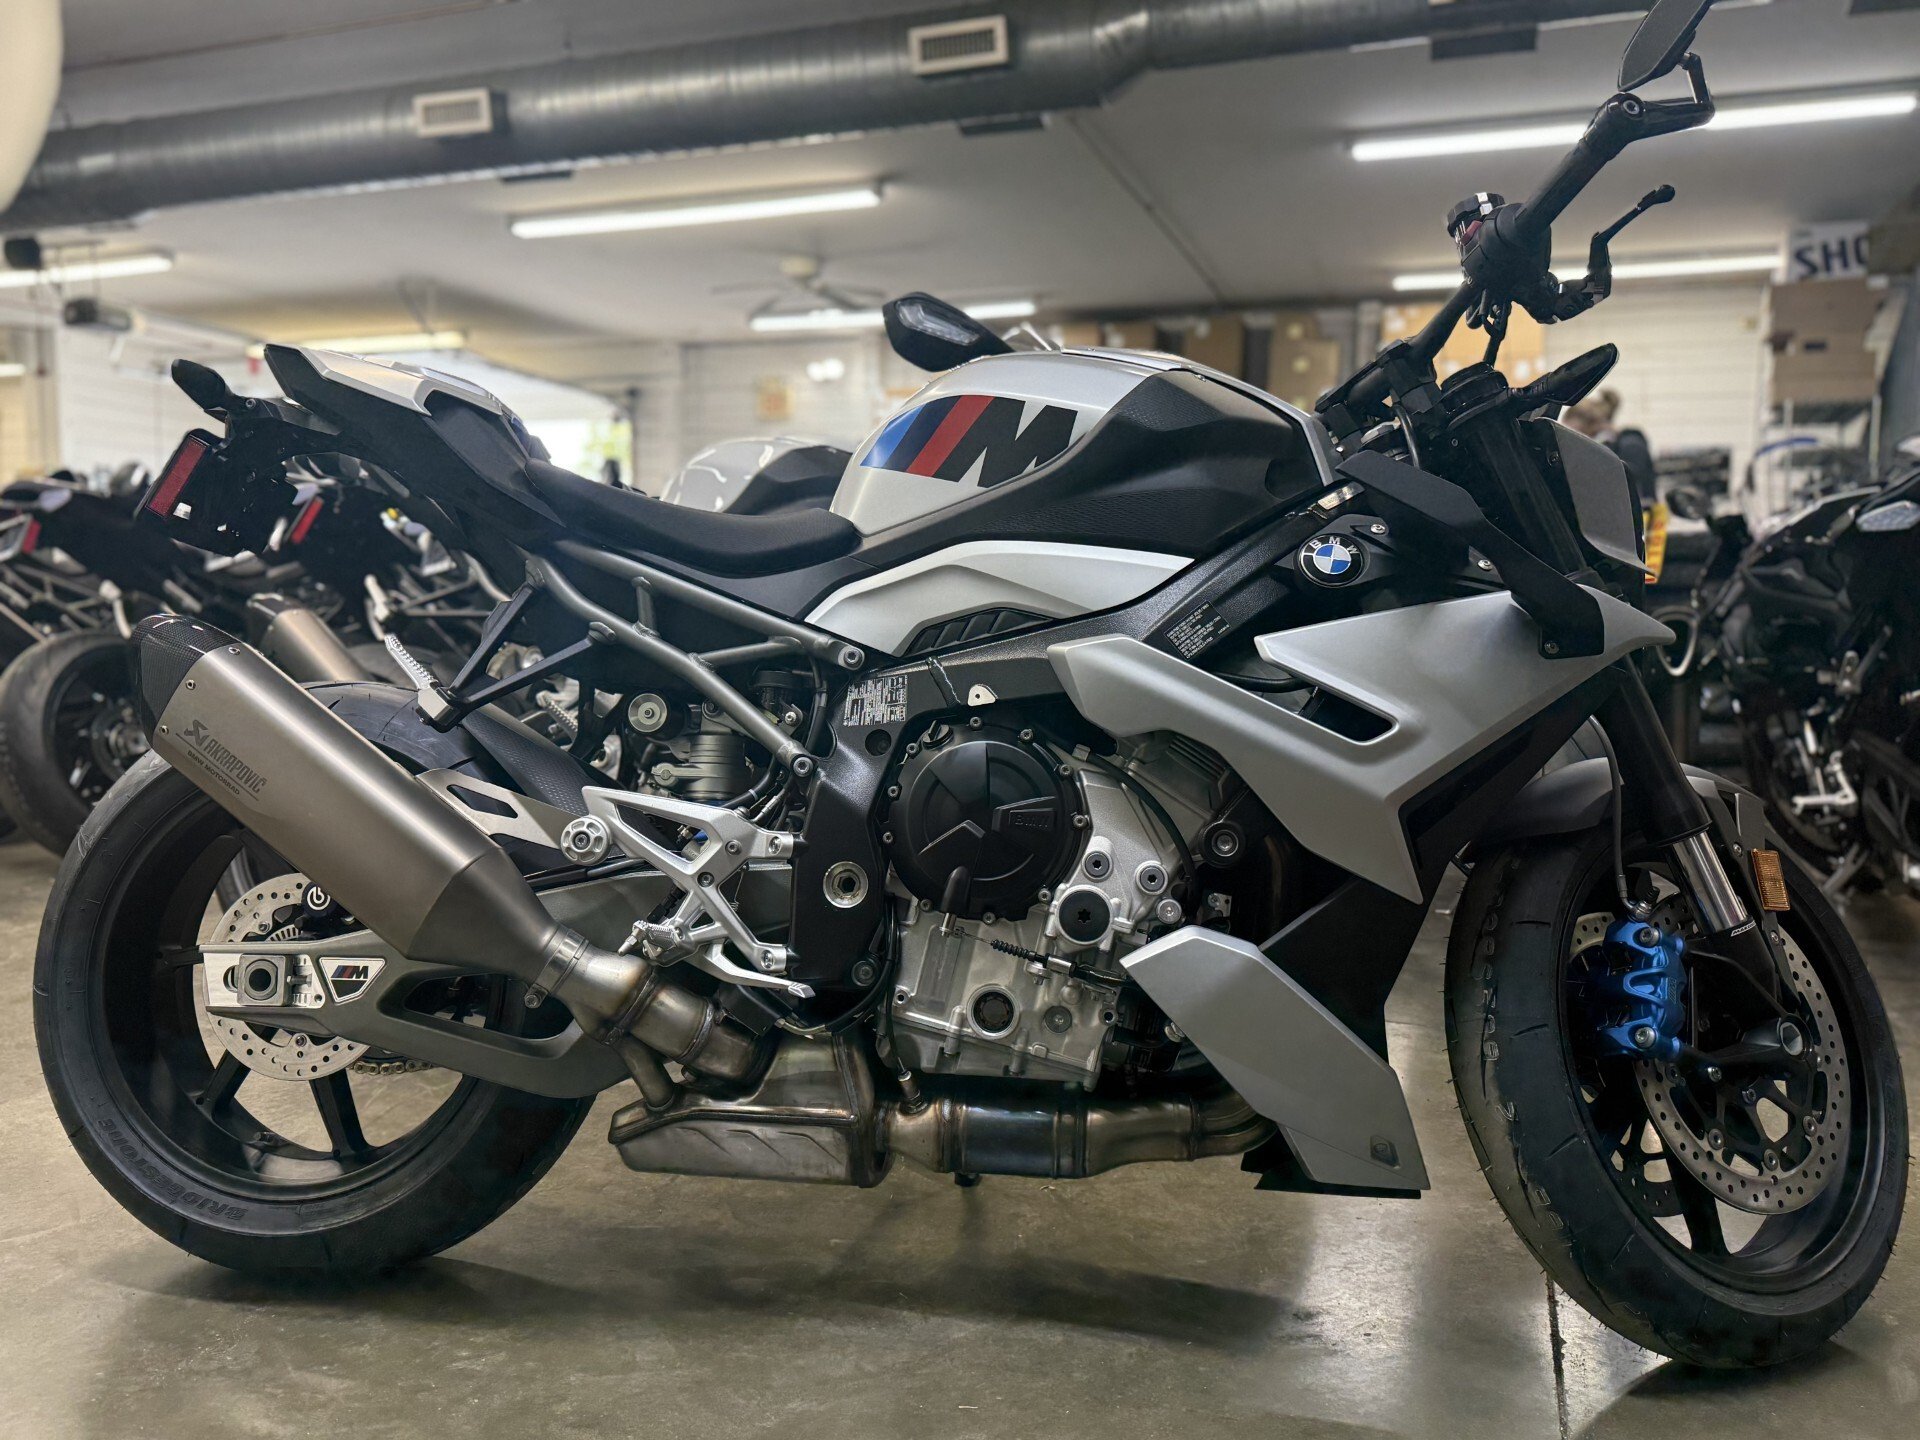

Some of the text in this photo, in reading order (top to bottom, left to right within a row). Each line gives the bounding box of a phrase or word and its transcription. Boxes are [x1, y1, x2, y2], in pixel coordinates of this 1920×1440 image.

[1309, 536, 1360, 554] BMW
[187, 749, 240, 795] BMW MOTORRAD
